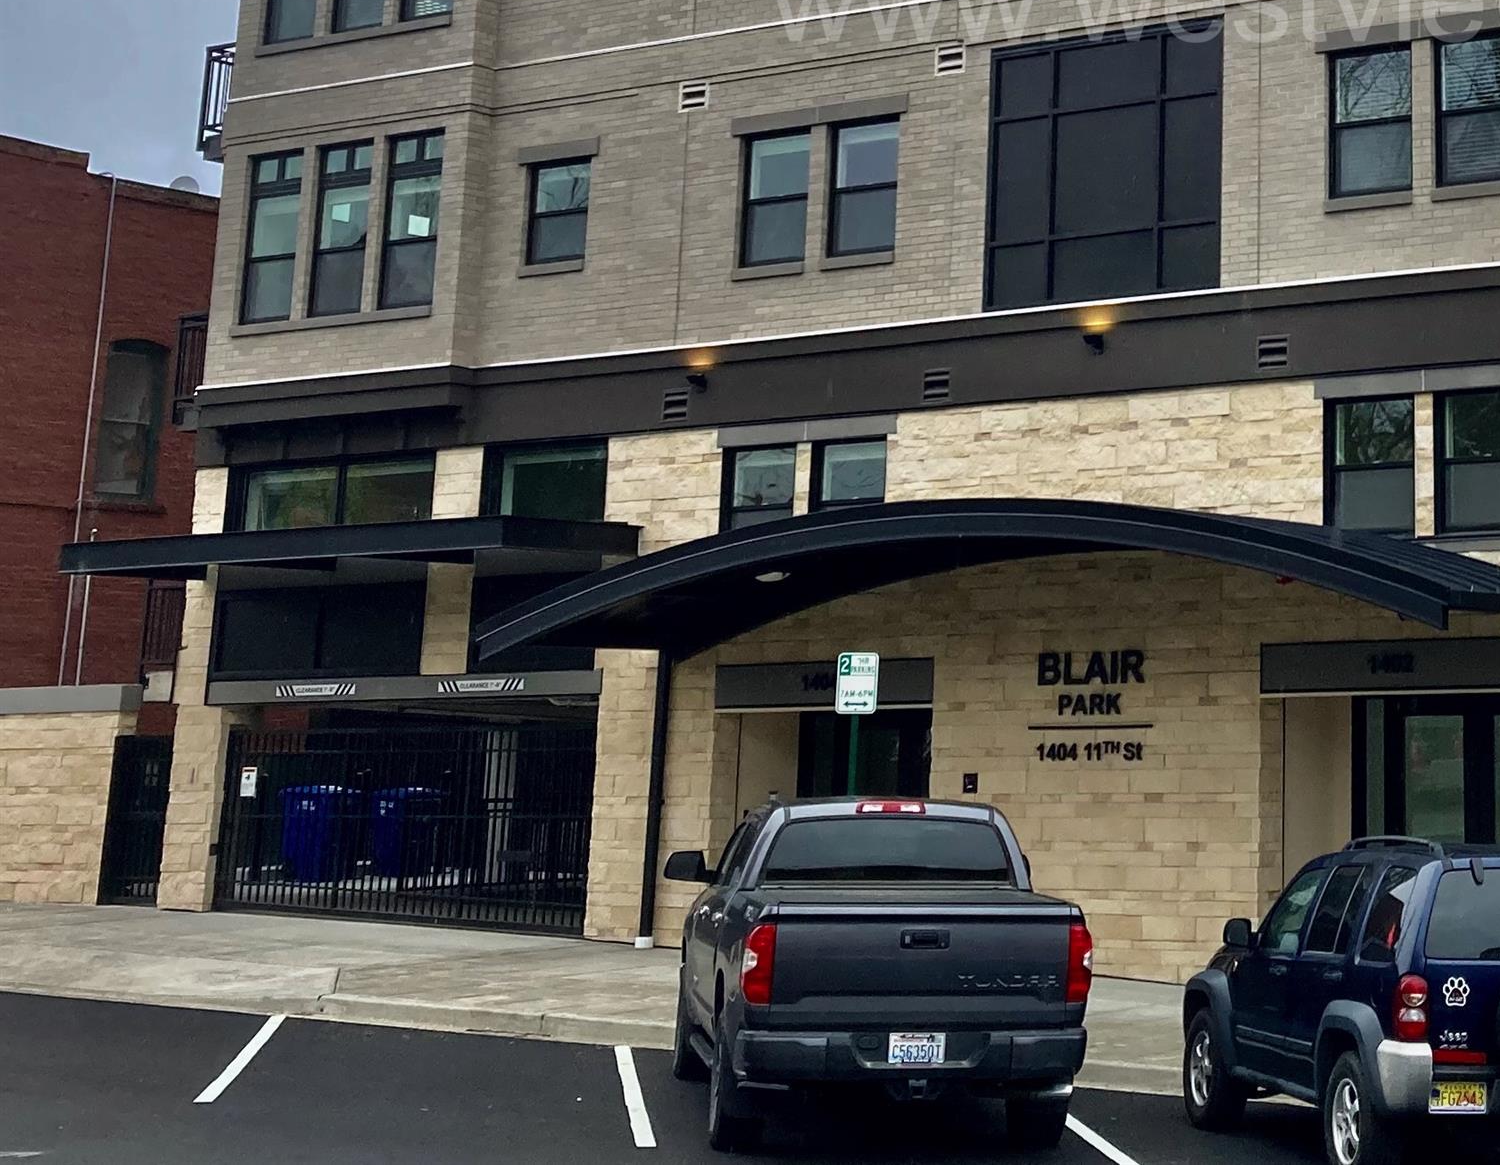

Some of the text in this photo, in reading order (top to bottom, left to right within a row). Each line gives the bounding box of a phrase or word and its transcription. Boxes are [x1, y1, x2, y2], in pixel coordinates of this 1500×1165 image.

[841, 657, 850, 672] 2
[1037, 649, 1145, 686] BLAIR
[1057, 692, 1121, 716] PARK
[1036, 742, 1078, 762] 1404
